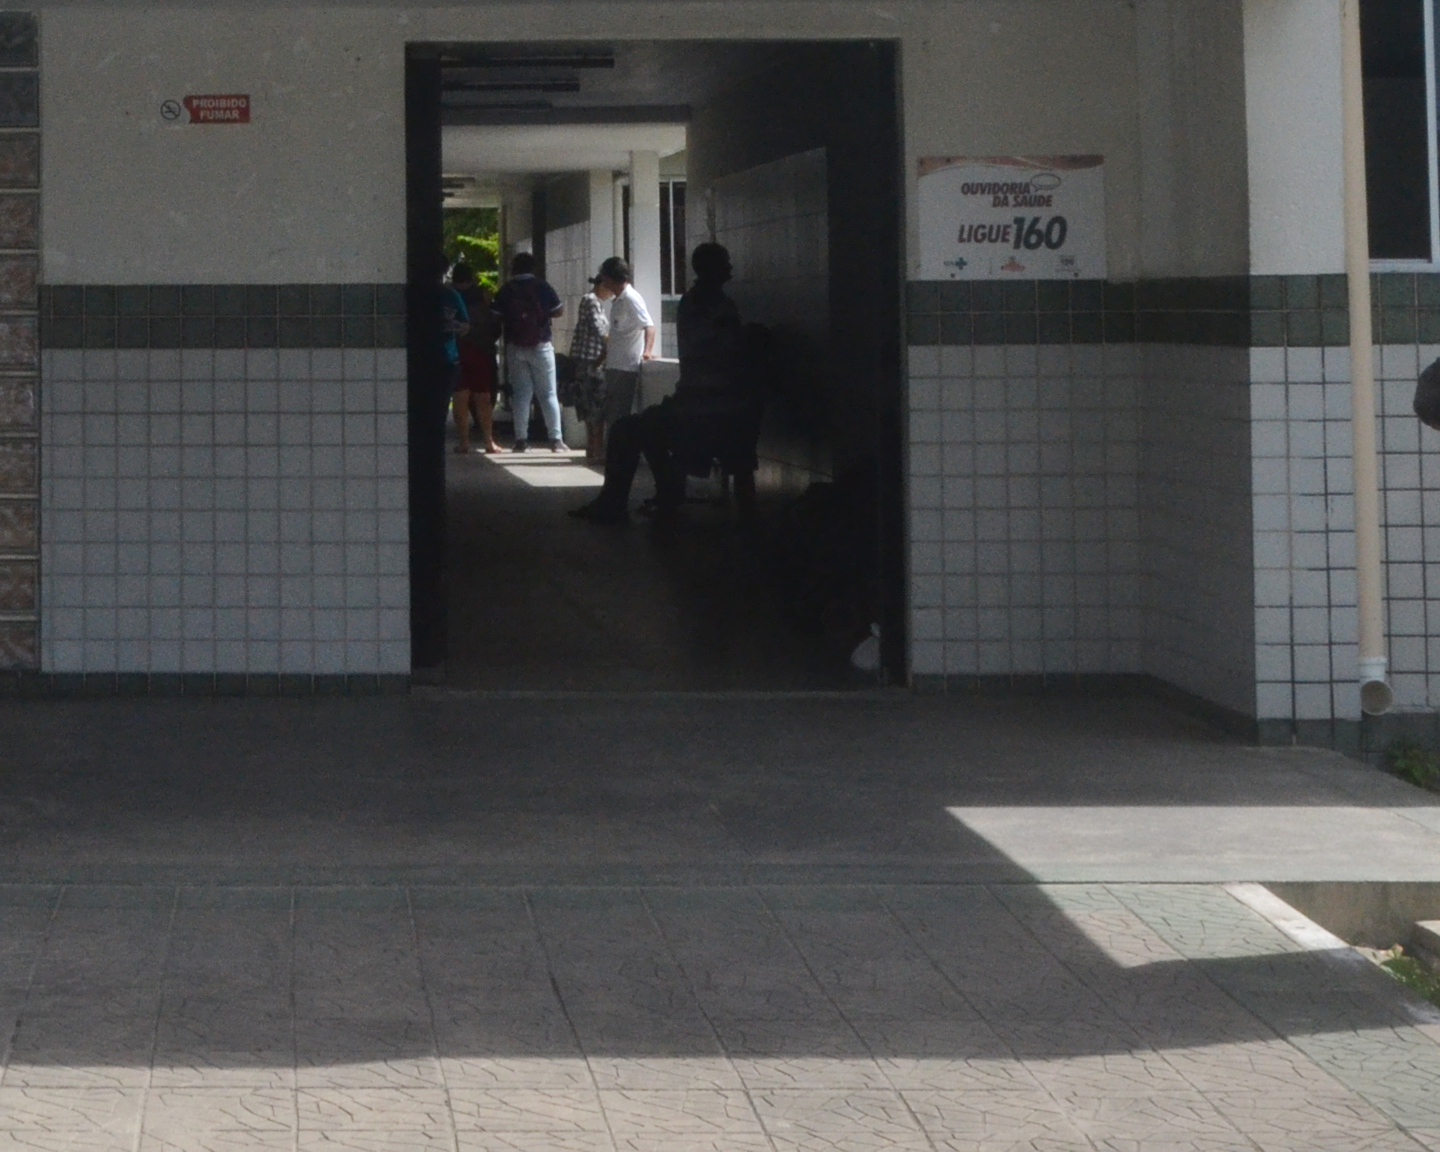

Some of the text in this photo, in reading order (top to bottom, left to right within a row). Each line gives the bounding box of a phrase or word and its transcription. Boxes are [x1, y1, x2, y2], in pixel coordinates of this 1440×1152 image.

[192, 98, 247, 108] PROIBIDO
[200, 109, 240, 119] FUMAR
[961, 182, 1030, 195] OUVIDORIA
[992, 195, 1009, 208] DA
[958, 215, 1068, 250] LIGUE 160
